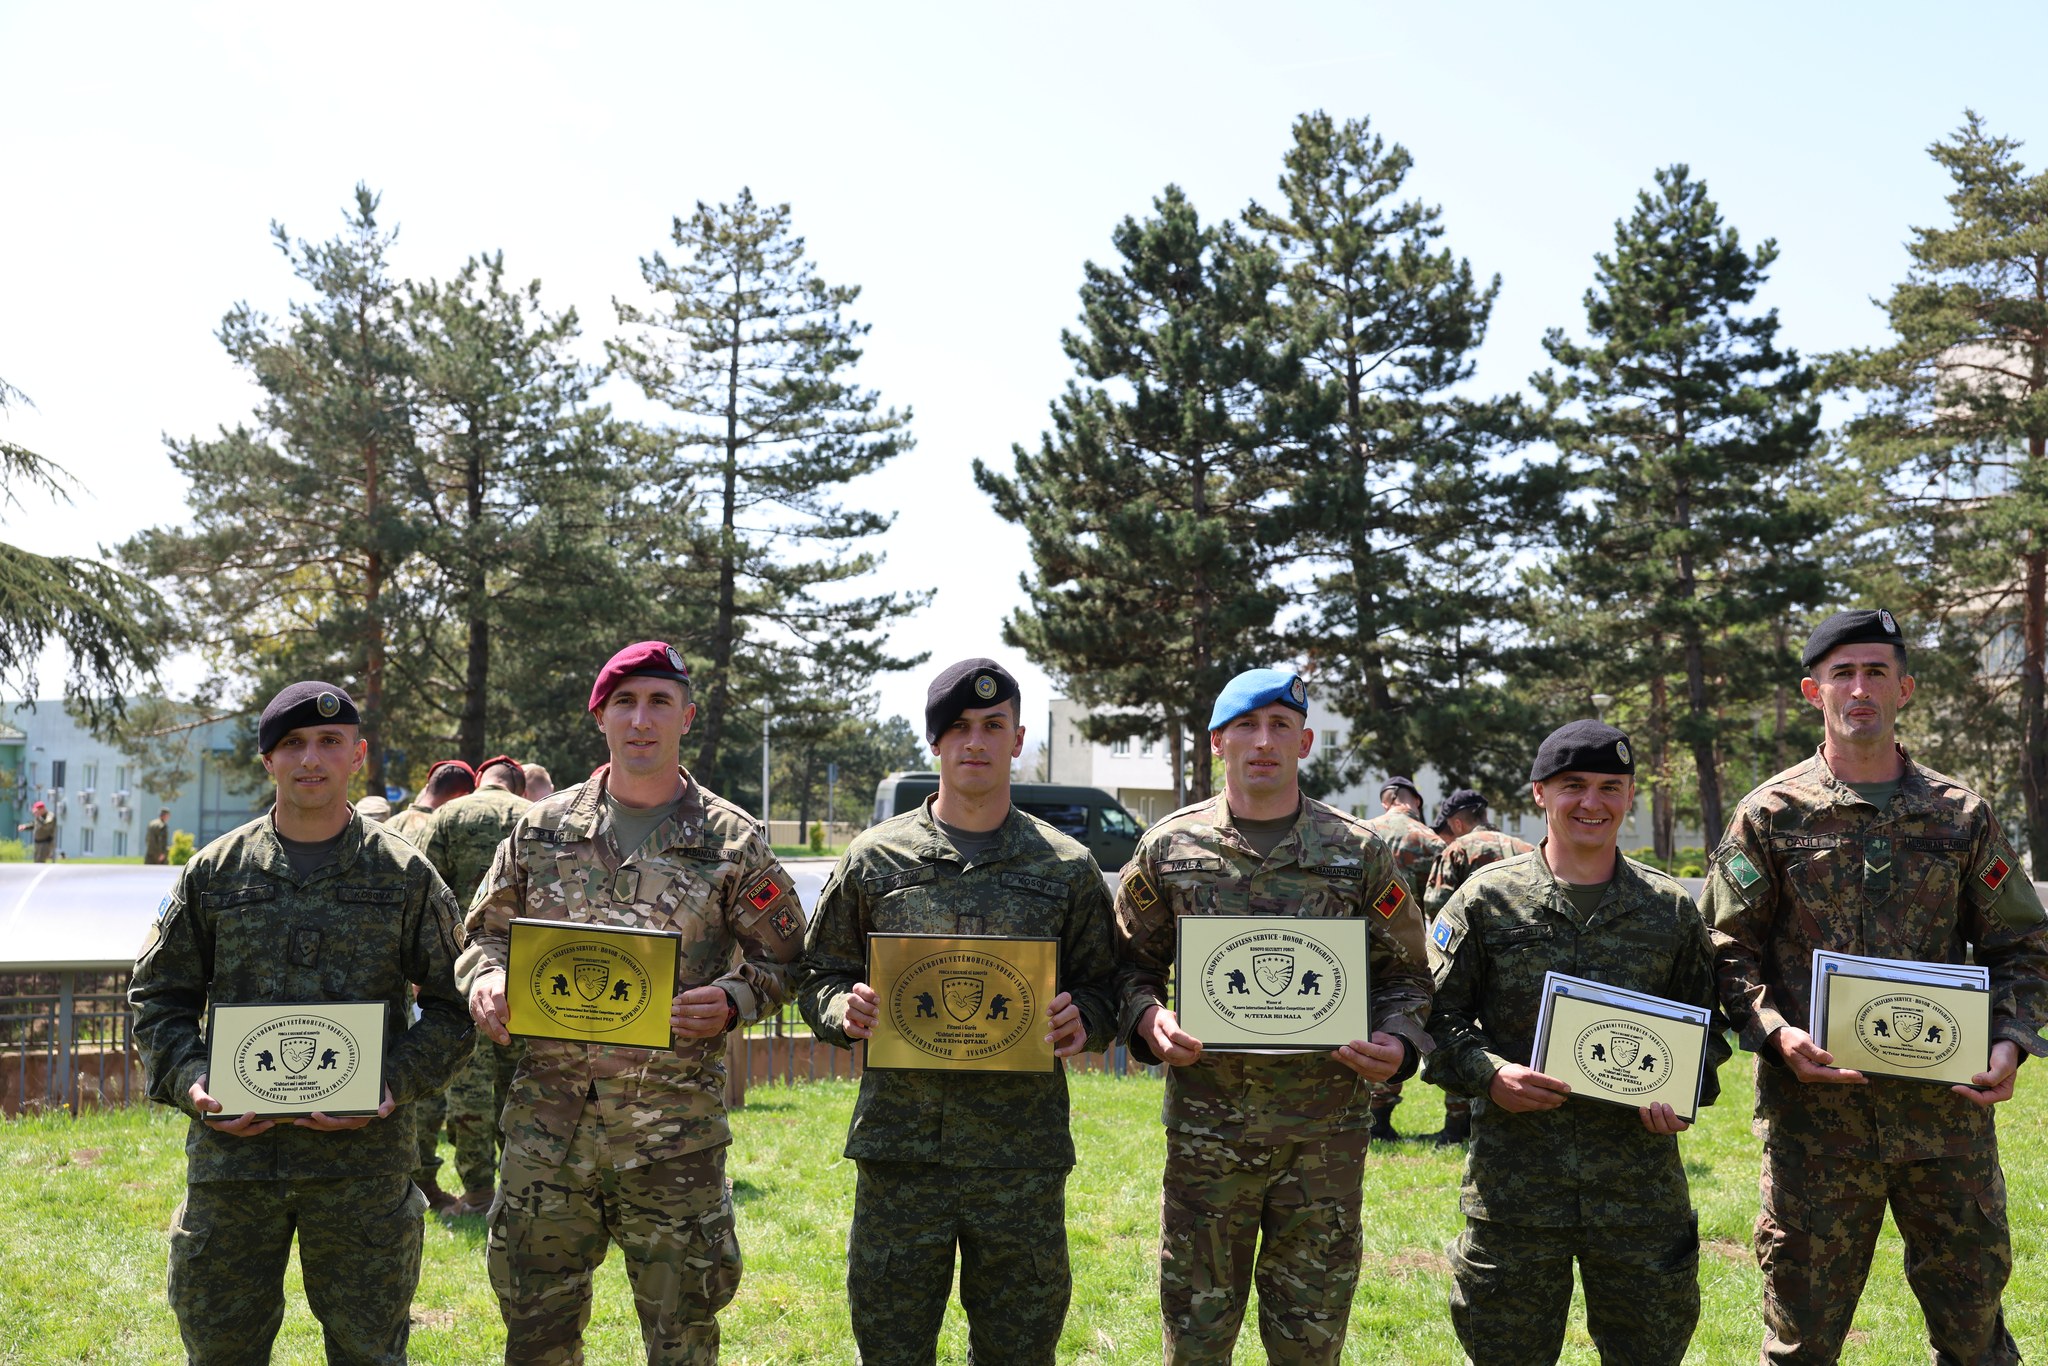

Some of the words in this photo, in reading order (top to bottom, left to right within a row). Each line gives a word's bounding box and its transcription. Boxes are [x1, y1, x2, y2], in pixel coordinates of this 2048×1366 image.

[1785, 838, 1820, 847] CAULI
[1172, 860, 1203, 870] MALA
[1982, 857, 1999, 878] ALBANIA
[750, 880, 770, 898] ALBANIA
[1018, 876, 1052, 892] KOSOVA
[355, 891, 392, 900] KOSOVA
[1378, 886, 1395, 904] ALBANIA
[1225, 937, 1252, 953] SELFLESS
[1253, 934, 1278, 943] SERVICE
[1282, 934, 1303, 945] HONOR
[553, 947, 576, 959] SELFLESS
[600, 946, 618, 957] HONOR
[1306, 941, 1335, 965] INTEGRITY
[537, 957, 552, 978] RESPECT
[620, 954, 642, 976] INTEGRITY
[996, 964, 1015, 980] NDERI
[1207, 952, 1225, 976] RESPECT
[895, 975, 913, 1007] RESPEKTI
[1206, 980, 1215, 997] DUTY
[1332, 967, 1342, 999] PERSONAL
[540, 998, 557, 1016] LOYALTY
[1015, 979, 1030, 1024] INTEGRITETI
[1212, 998, 1236, 1020] LOYALTY
[1312, 1000, 1336, 1020] COURAGE
[1860, 1005, 1873, 1022] RESPECT
[1915, 999, 1931, 1008] HONOR
[1932, 1005, 1952, 1024] INTEGRITY
[327, 1025, 342, 1037] NDERI
[967, 1043, 1002, 1056] PERSONAL
